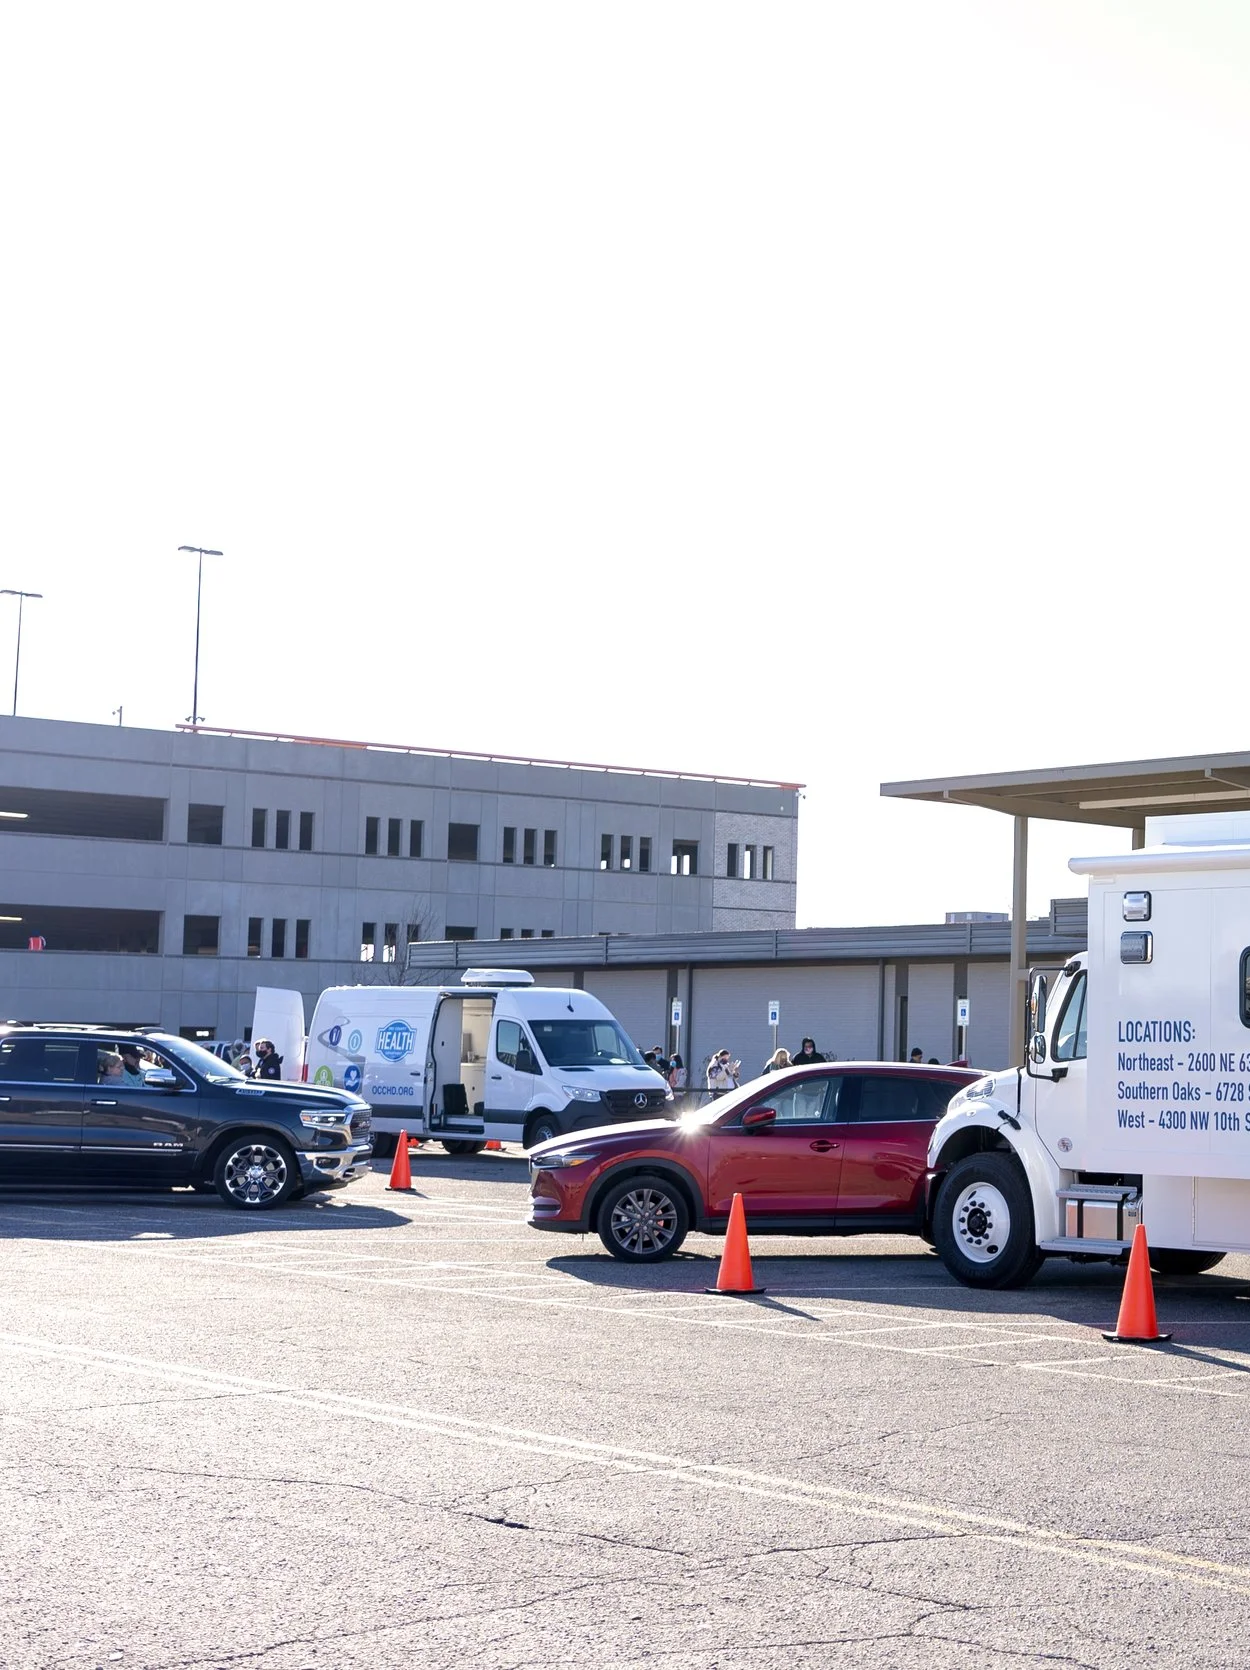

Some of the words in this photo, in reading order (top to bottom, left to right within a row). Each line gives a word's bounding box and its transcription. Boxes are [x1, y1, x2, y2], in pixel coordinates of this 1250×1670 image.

[378, 1031, 414, 1051] HEALTH
[1118, 1020, 1196, 1043] LOCATIONS:
[1118, 1052, 1174, 1071] Northeast
[1188, 1052, 1216, 1072] 2600
[1220, 1052, 1235, 1073] NE
[372, 1085, 414, 1096] OCCHD.ORG
[1117, 1080, 1169, 1100] Southern
[1172, 1081, 1201, 1101] Oaks
[1216, 1082, 1244, 1102] 6728
[1117, 1109, 1145, 1128] West
[1158, 1110, 1187, 1130] 4300
[1190, 1111, 1210, 1131] NW
[1213, 1112, 1240, 1132] 10th
